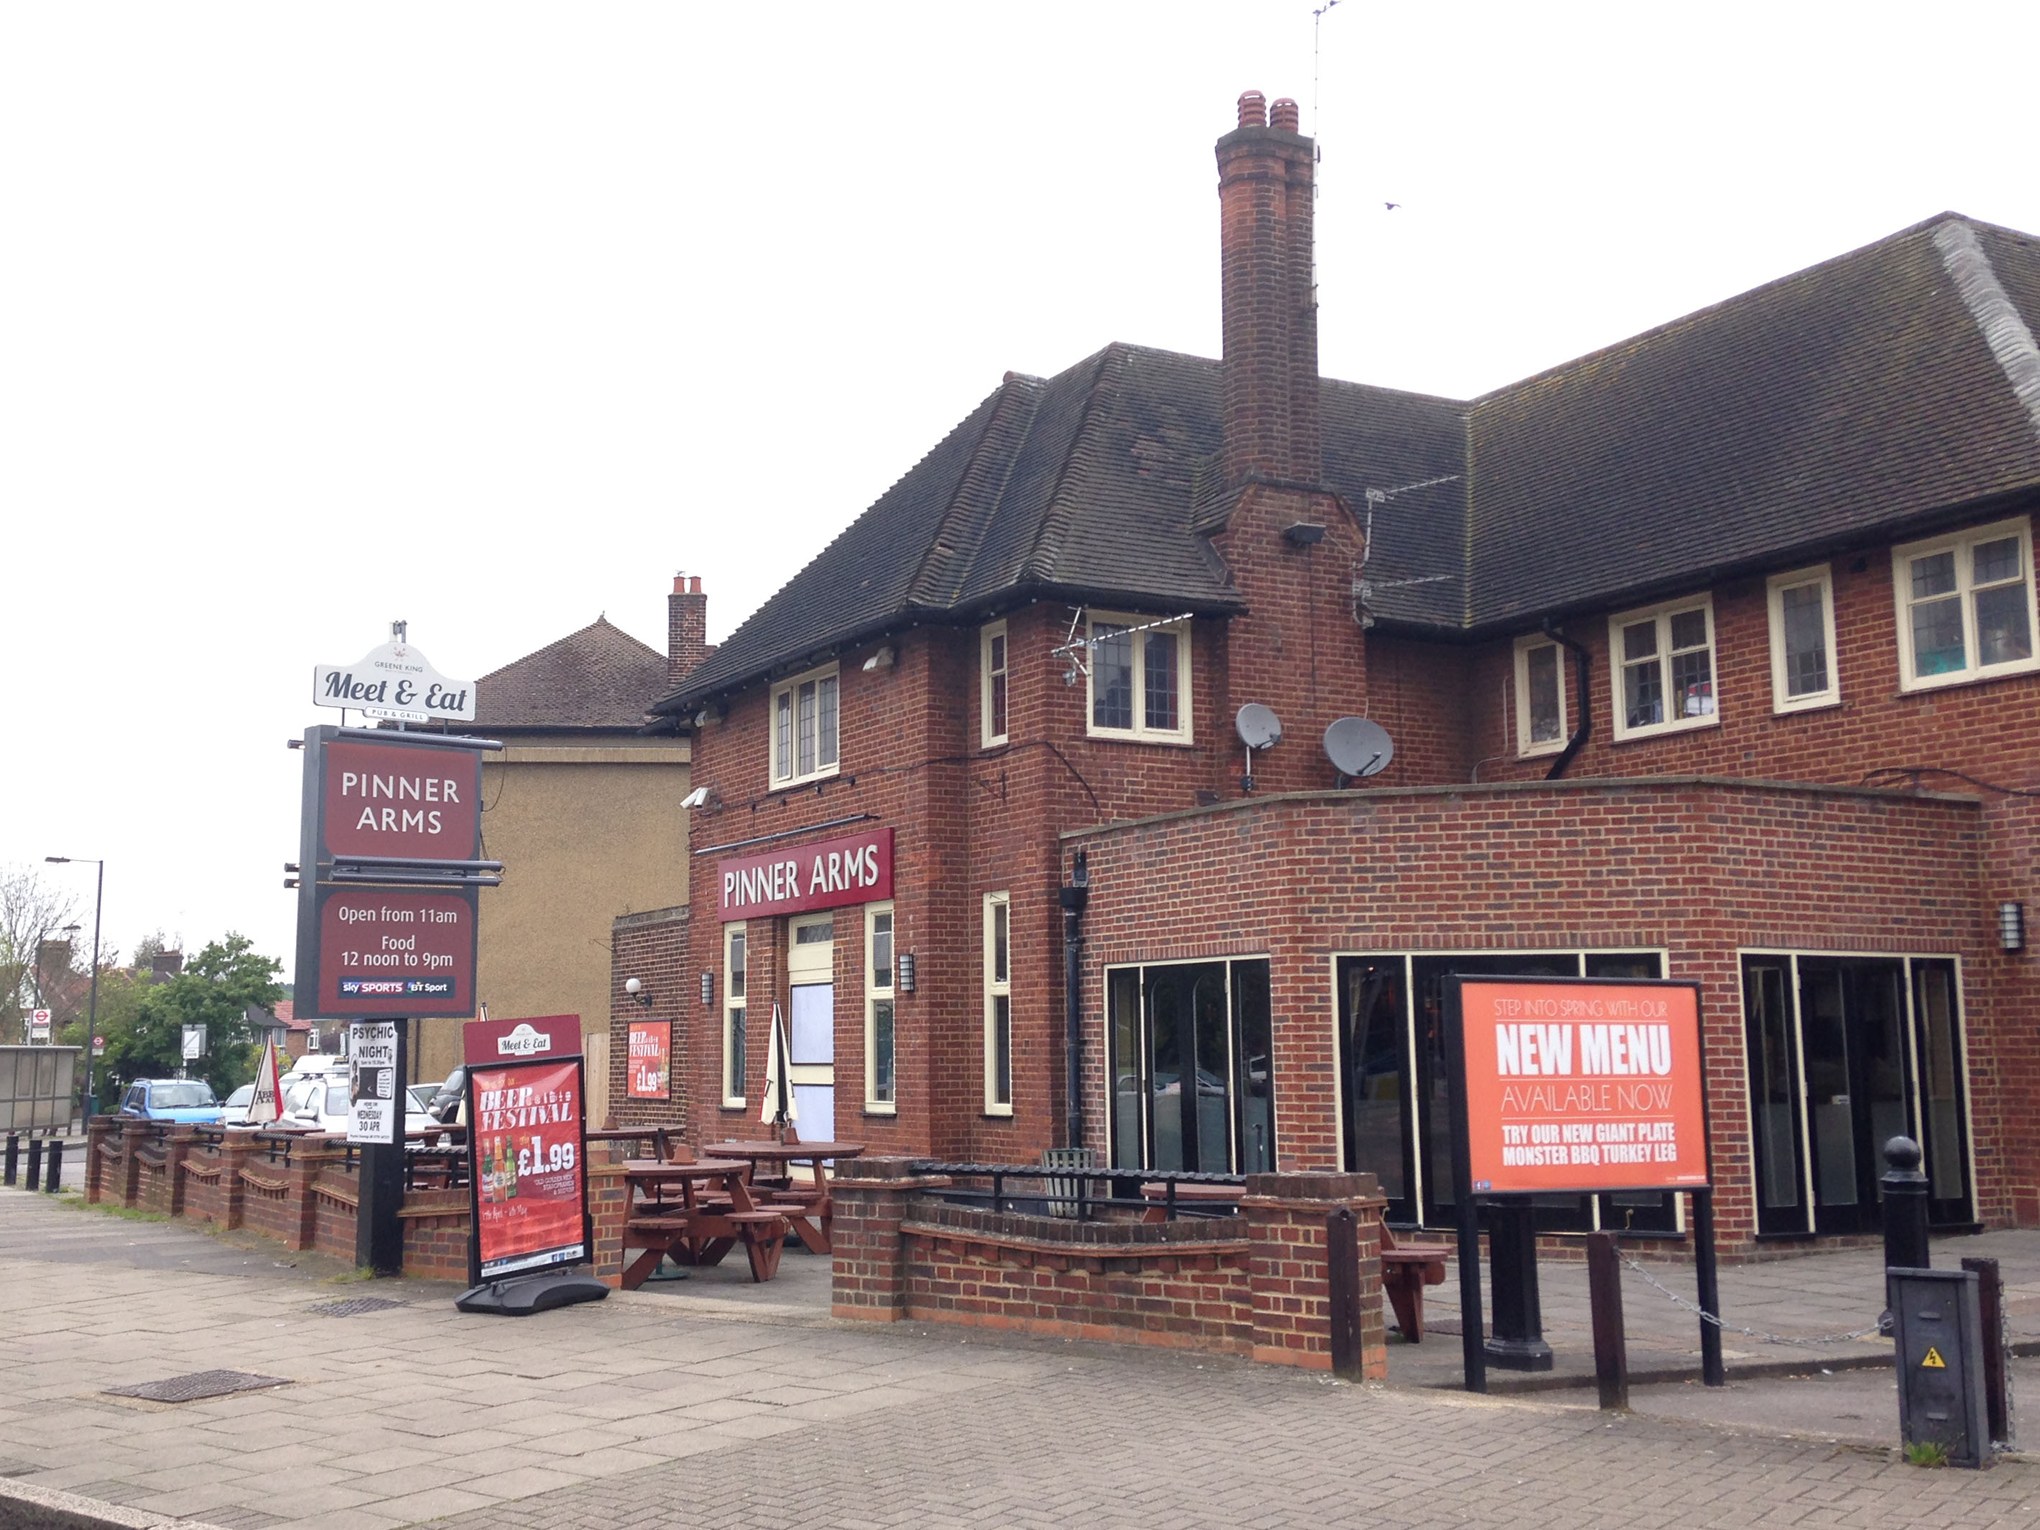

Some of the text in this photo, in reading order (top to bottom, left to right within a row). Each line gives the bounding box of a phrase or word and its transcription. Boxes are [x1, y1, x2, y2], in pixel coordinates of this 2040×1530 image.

[374, 660, 402, 671] GREENE
[405, 665, 423, 673] KING
[325, 671, 467, 712] Meet & Eat
[372, 709, 388, 717] PUB
[400, 712, 423, 720] GRILL
[342, 772, 460, 803] PINNER
[356, 806, 441, 834] ARMS
[724, 844, 879, 908] PINNER ARMS
[338, 906, 457, 925] Open from 11am
[382, 935, 415, 950] Food
[342, 952, 453, 970] 12 noon to 9pm
[343, 982, 447, 993] sky SPORTS BT Sport
[1494, 999, 1667, 1017] STEP INTO SPRING WITH OUR
[352, 1026, 394, 1039] PSYCHIC
[358, 1046, 389, 1058] NIGHT
[501, 1037, 546, 1051] Meet & Eat
[629, 1044, 659, 1057] FESTIVAL
[1496, 1024, 1672, 1075] NEW MENU
[636, 1065, 657, 1092] £1.99
[1501, 1084, 1673, 1112] AVAILABLE NOW
[357, 1110, 382, 1120] WEDNESDAY
[479, 1102, 573, 1132] FESTIVAL
[359, 1121, 380, 1131] 30 APR
[1502, 1122, 1675, 1144] TRY OUR NEW GIANT PLATE
[518, 1135, 575, 1177] £1.99
[1503, 1143, 1677, 1166] MONSTER BBQ TURKEY LEG
